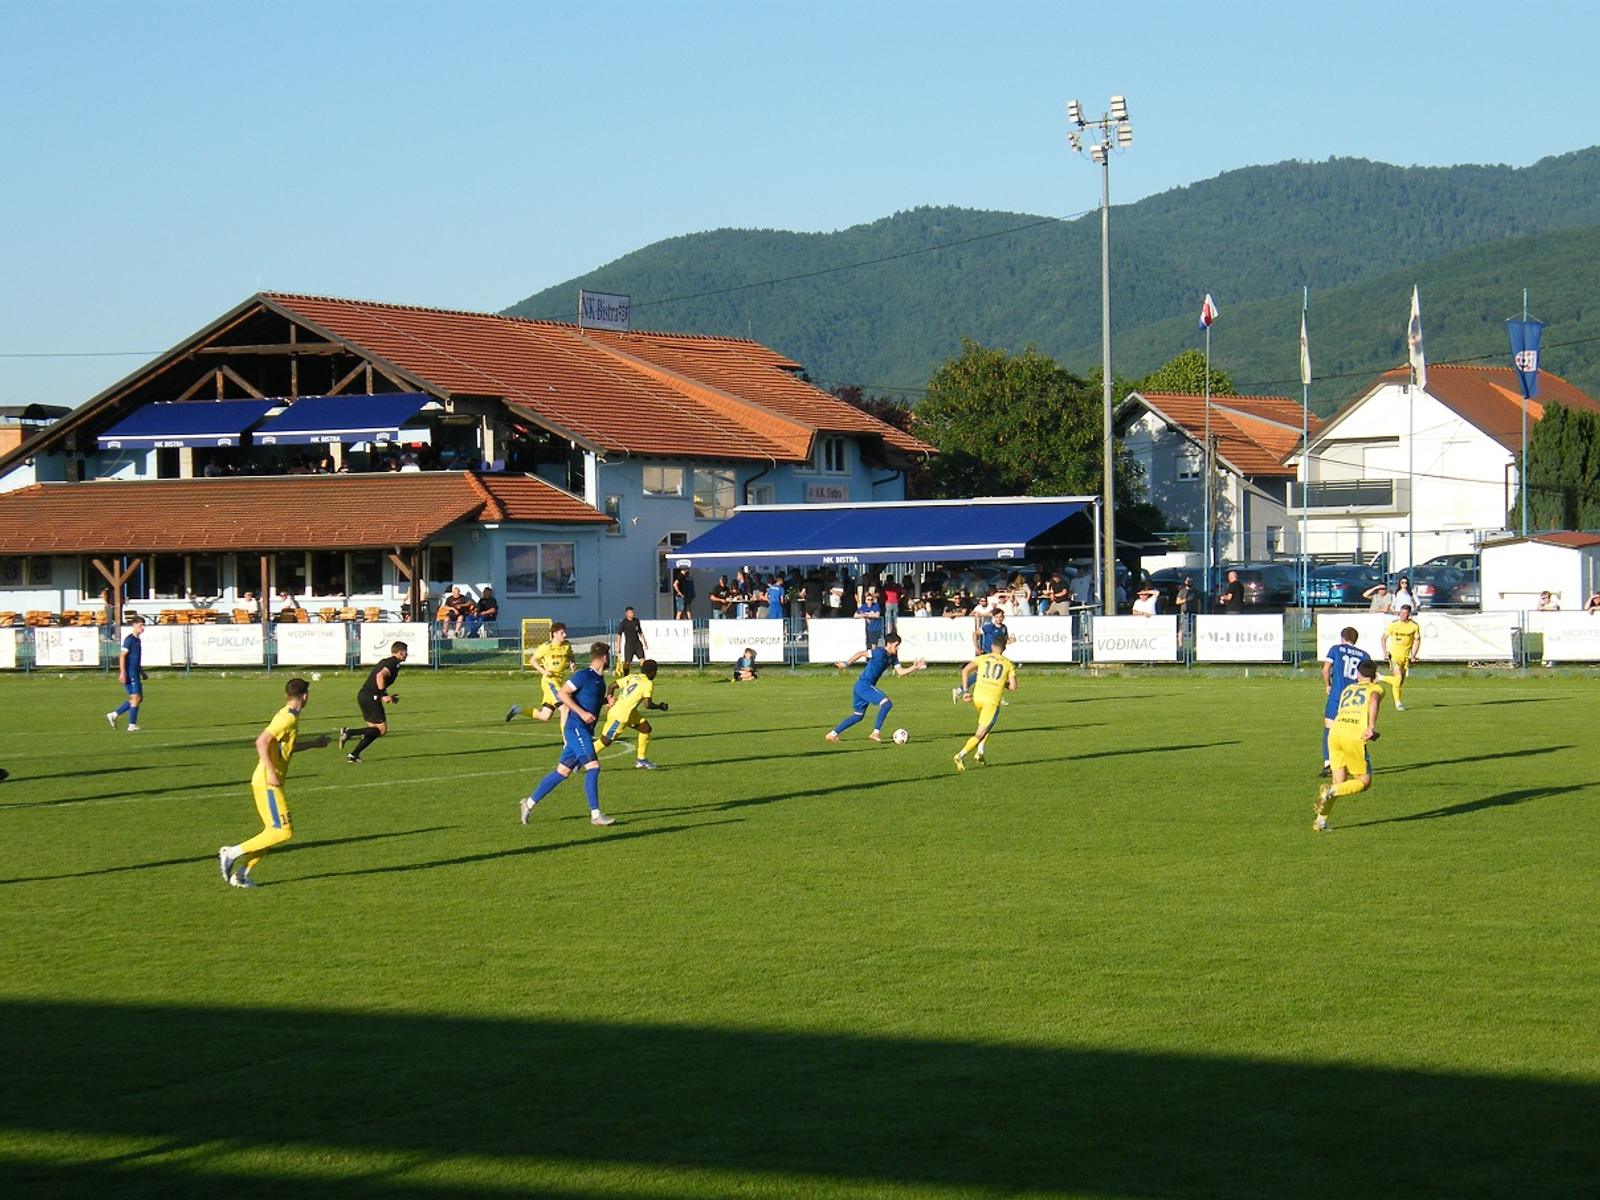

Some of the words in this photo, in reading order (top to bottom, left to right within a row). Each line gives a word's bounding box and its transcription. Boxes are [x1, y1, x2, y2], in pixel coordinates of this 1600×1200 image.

[823, 556, 834, 564] NK
[835, 555, 859, 564] BISTRA
[207, 636, 255, 647] PUKLIN
[727, 636, 781, 646] VINKOPROM
[1011, 631, 1068, 643] Accolade
[983, 661, 1004, 680] 10
[1340, 687, 1366, 708] 25
